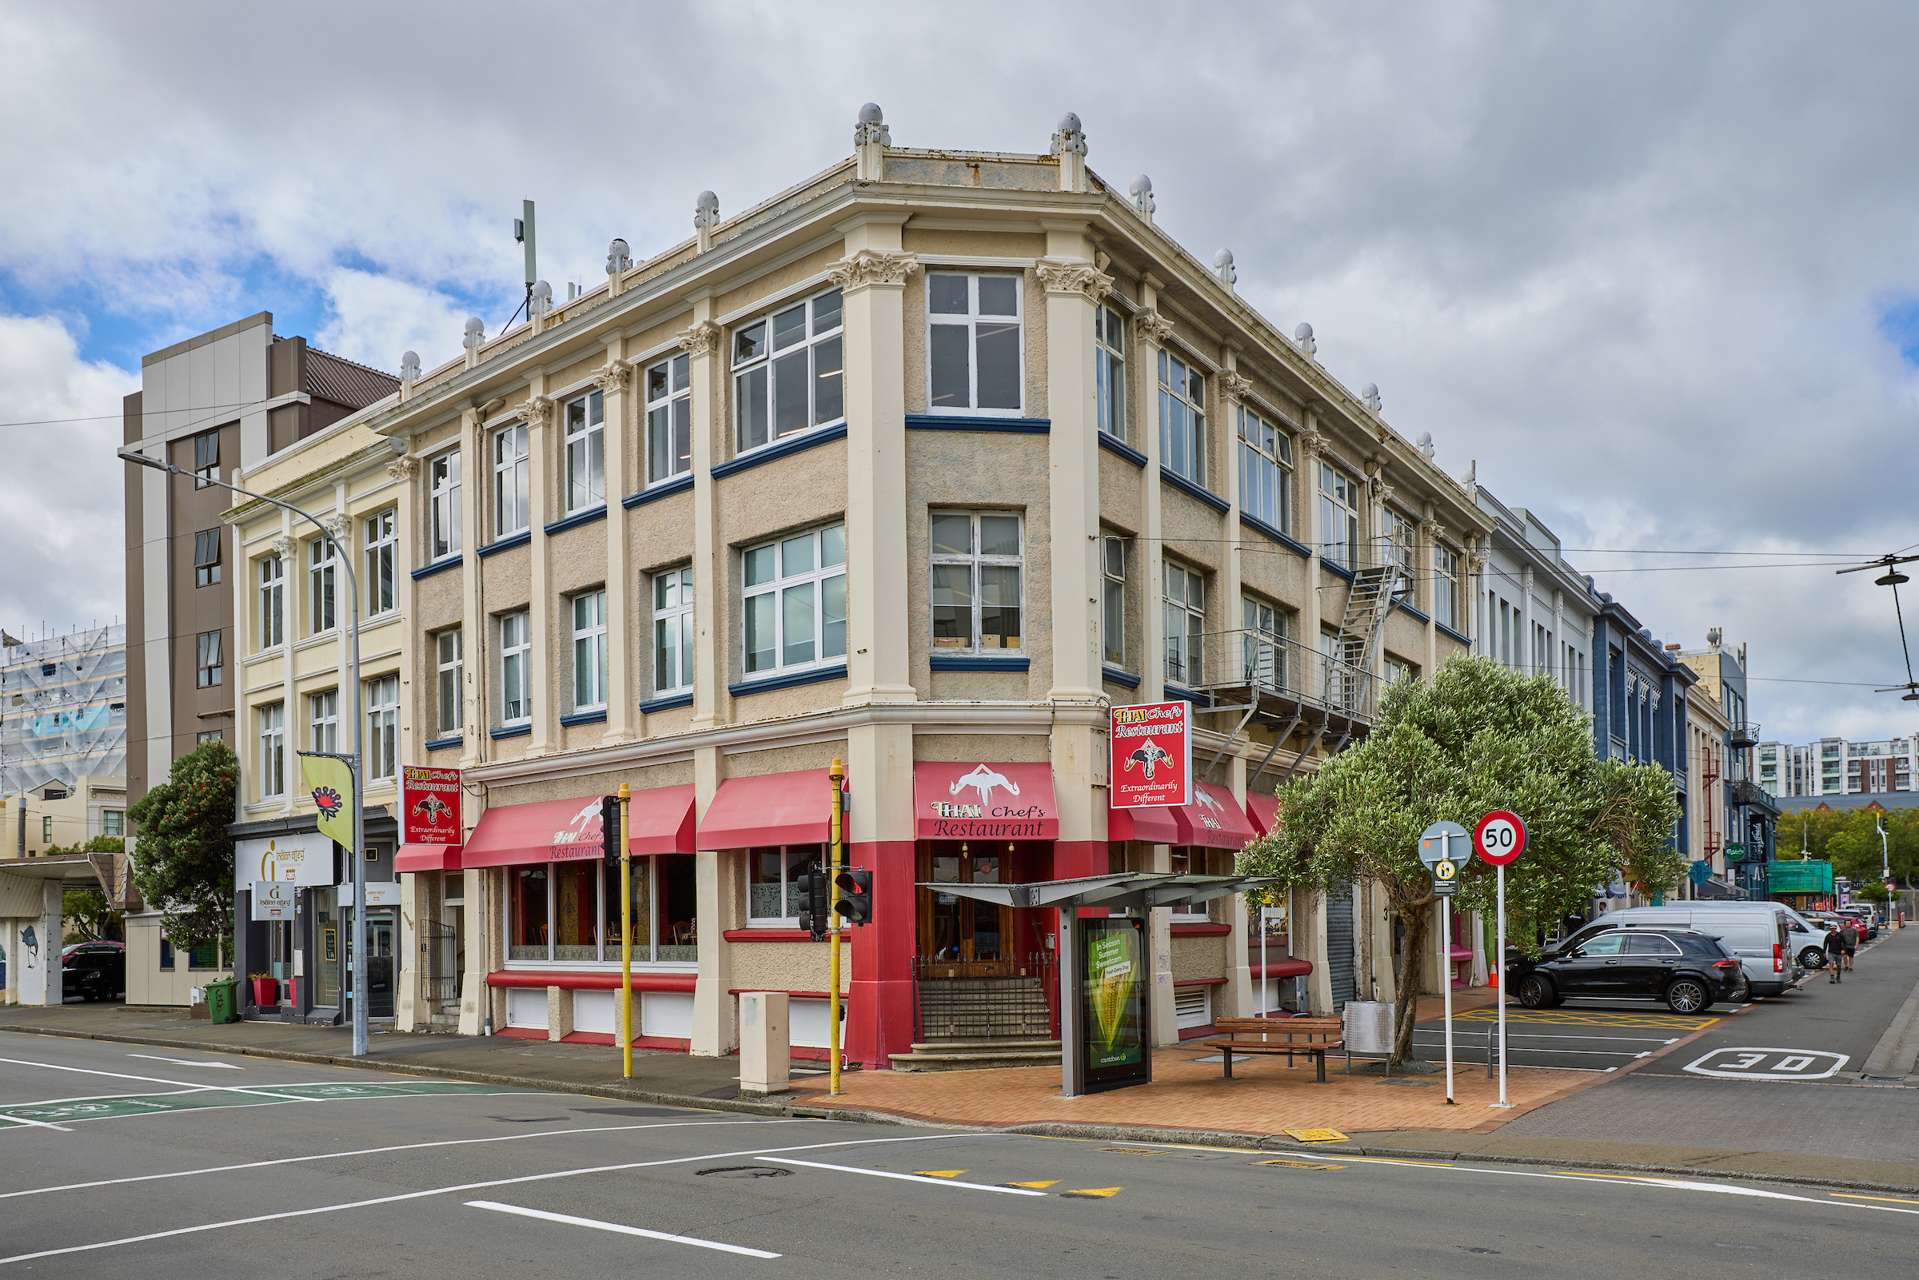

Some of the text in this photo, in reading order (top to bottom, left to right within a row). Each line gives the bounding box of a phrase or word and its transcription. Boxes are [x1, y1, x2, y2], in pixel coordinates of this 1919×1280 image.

[1114, 709, 1147, 724] THAI
[1115, 721, 1184, 738] Restaurant
[405, 767, 430, 779] THAI
[406, 780, 458, 792] Restaurant
[1120, 780, 1178, 793] Extraordinarily
[1133, 793, 1166, 805] Different
[930, 801, 982, 818] THAI
[410, 826, 455, 836] Extraordinarily
[934, 820, 1044, 837] Restaurant
[421, 834, 446, 844] Different
[1485, 828, 1512, 848] 50
[550, 845, 600, 859] Restaurant
[1717, 1053, 1817, 1072] 30
